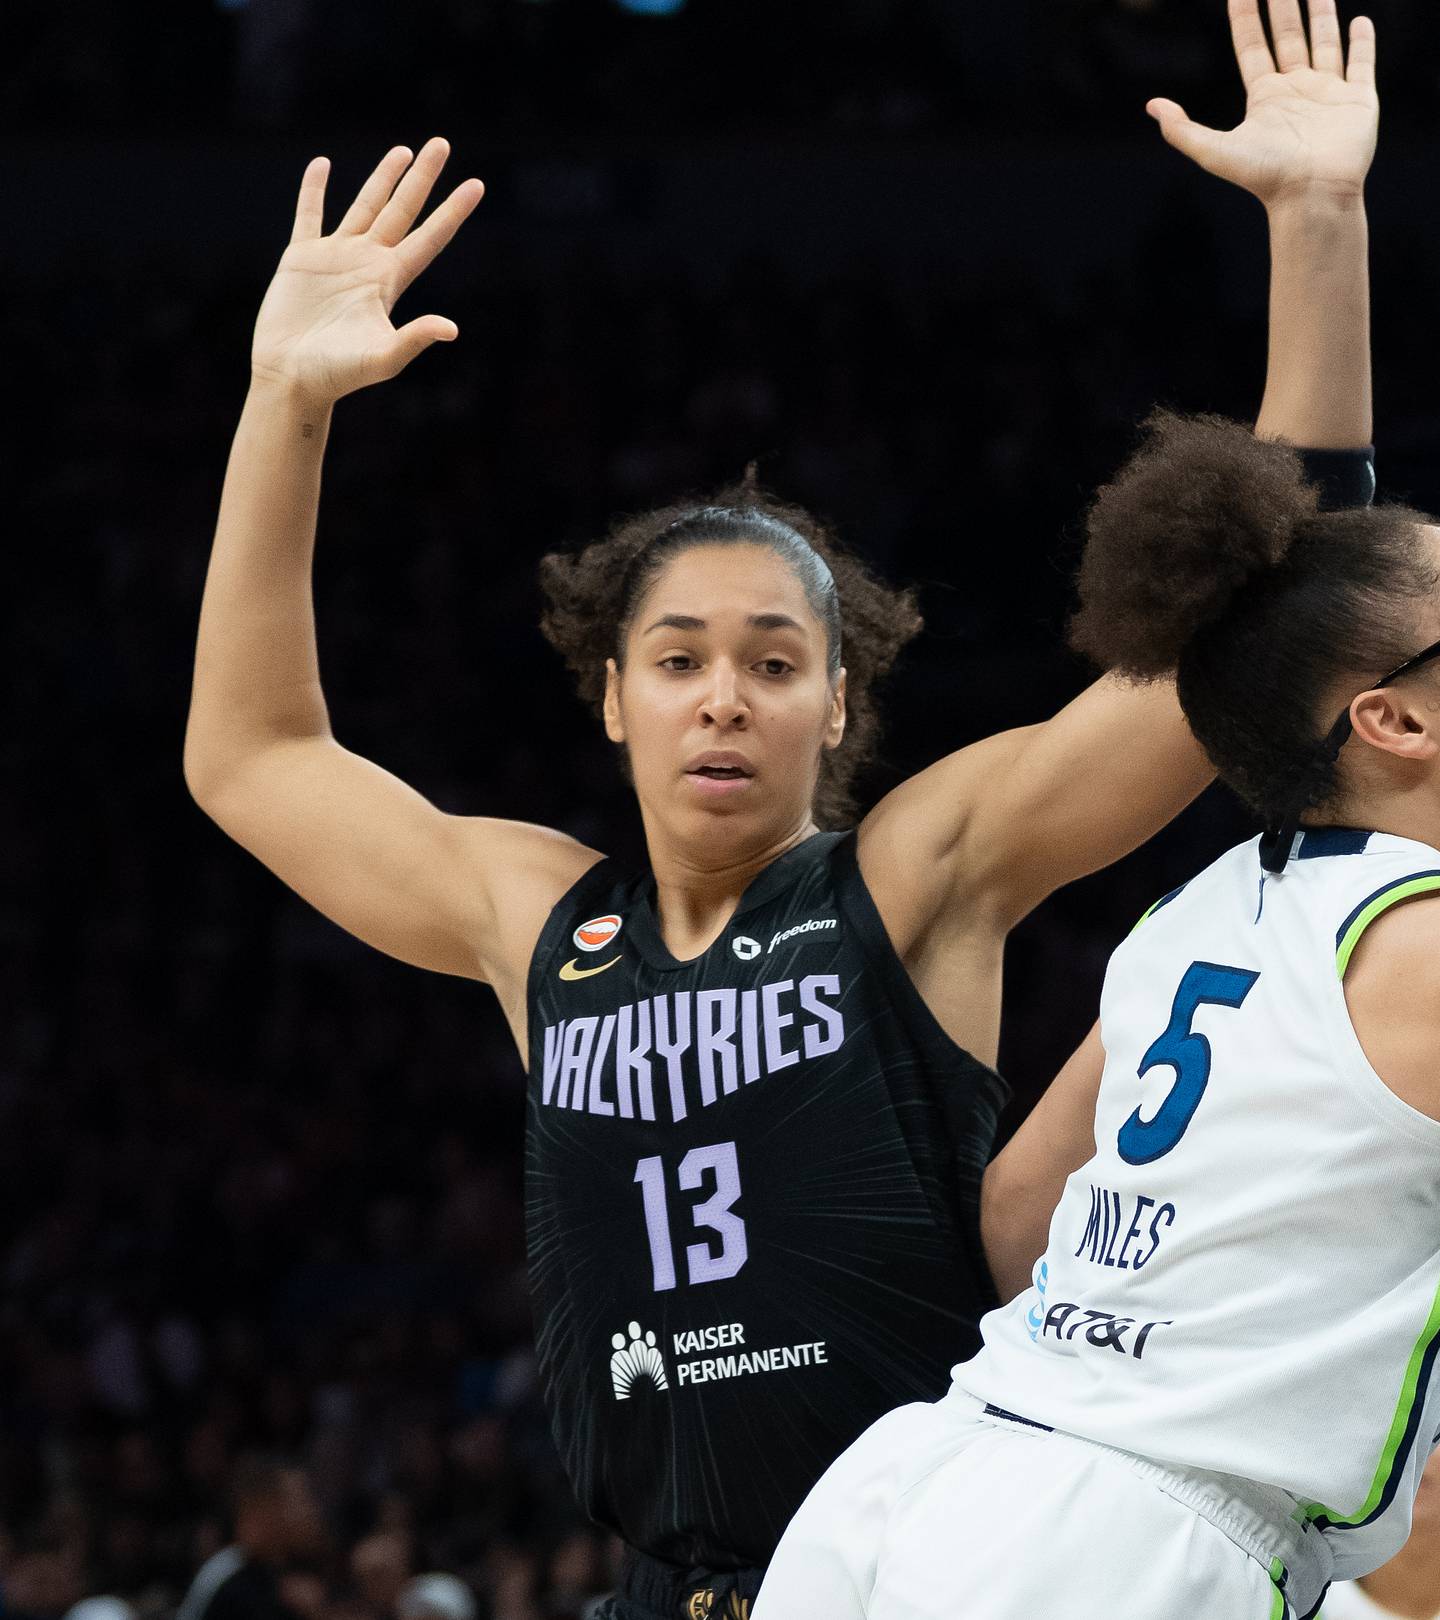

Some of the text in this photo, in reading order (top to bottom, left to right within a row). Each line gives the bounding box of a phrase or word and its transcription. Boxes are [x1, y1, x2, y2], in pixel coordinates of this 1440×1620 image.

[767, 919, 837, 954] freedom
[542, 974, 845, 1123] VALKYRIES
[1117, 960, 1262, 1166] 5
[633, 1141, 749, 1292] 13
[1074, 1184, 1176, 1271] MILES
[673, 1322, 745, 1355] KAISER
[677, 1341, 829, 1386] PERMANENTE
[1042, 1302, 1175, 1360] AT&T
